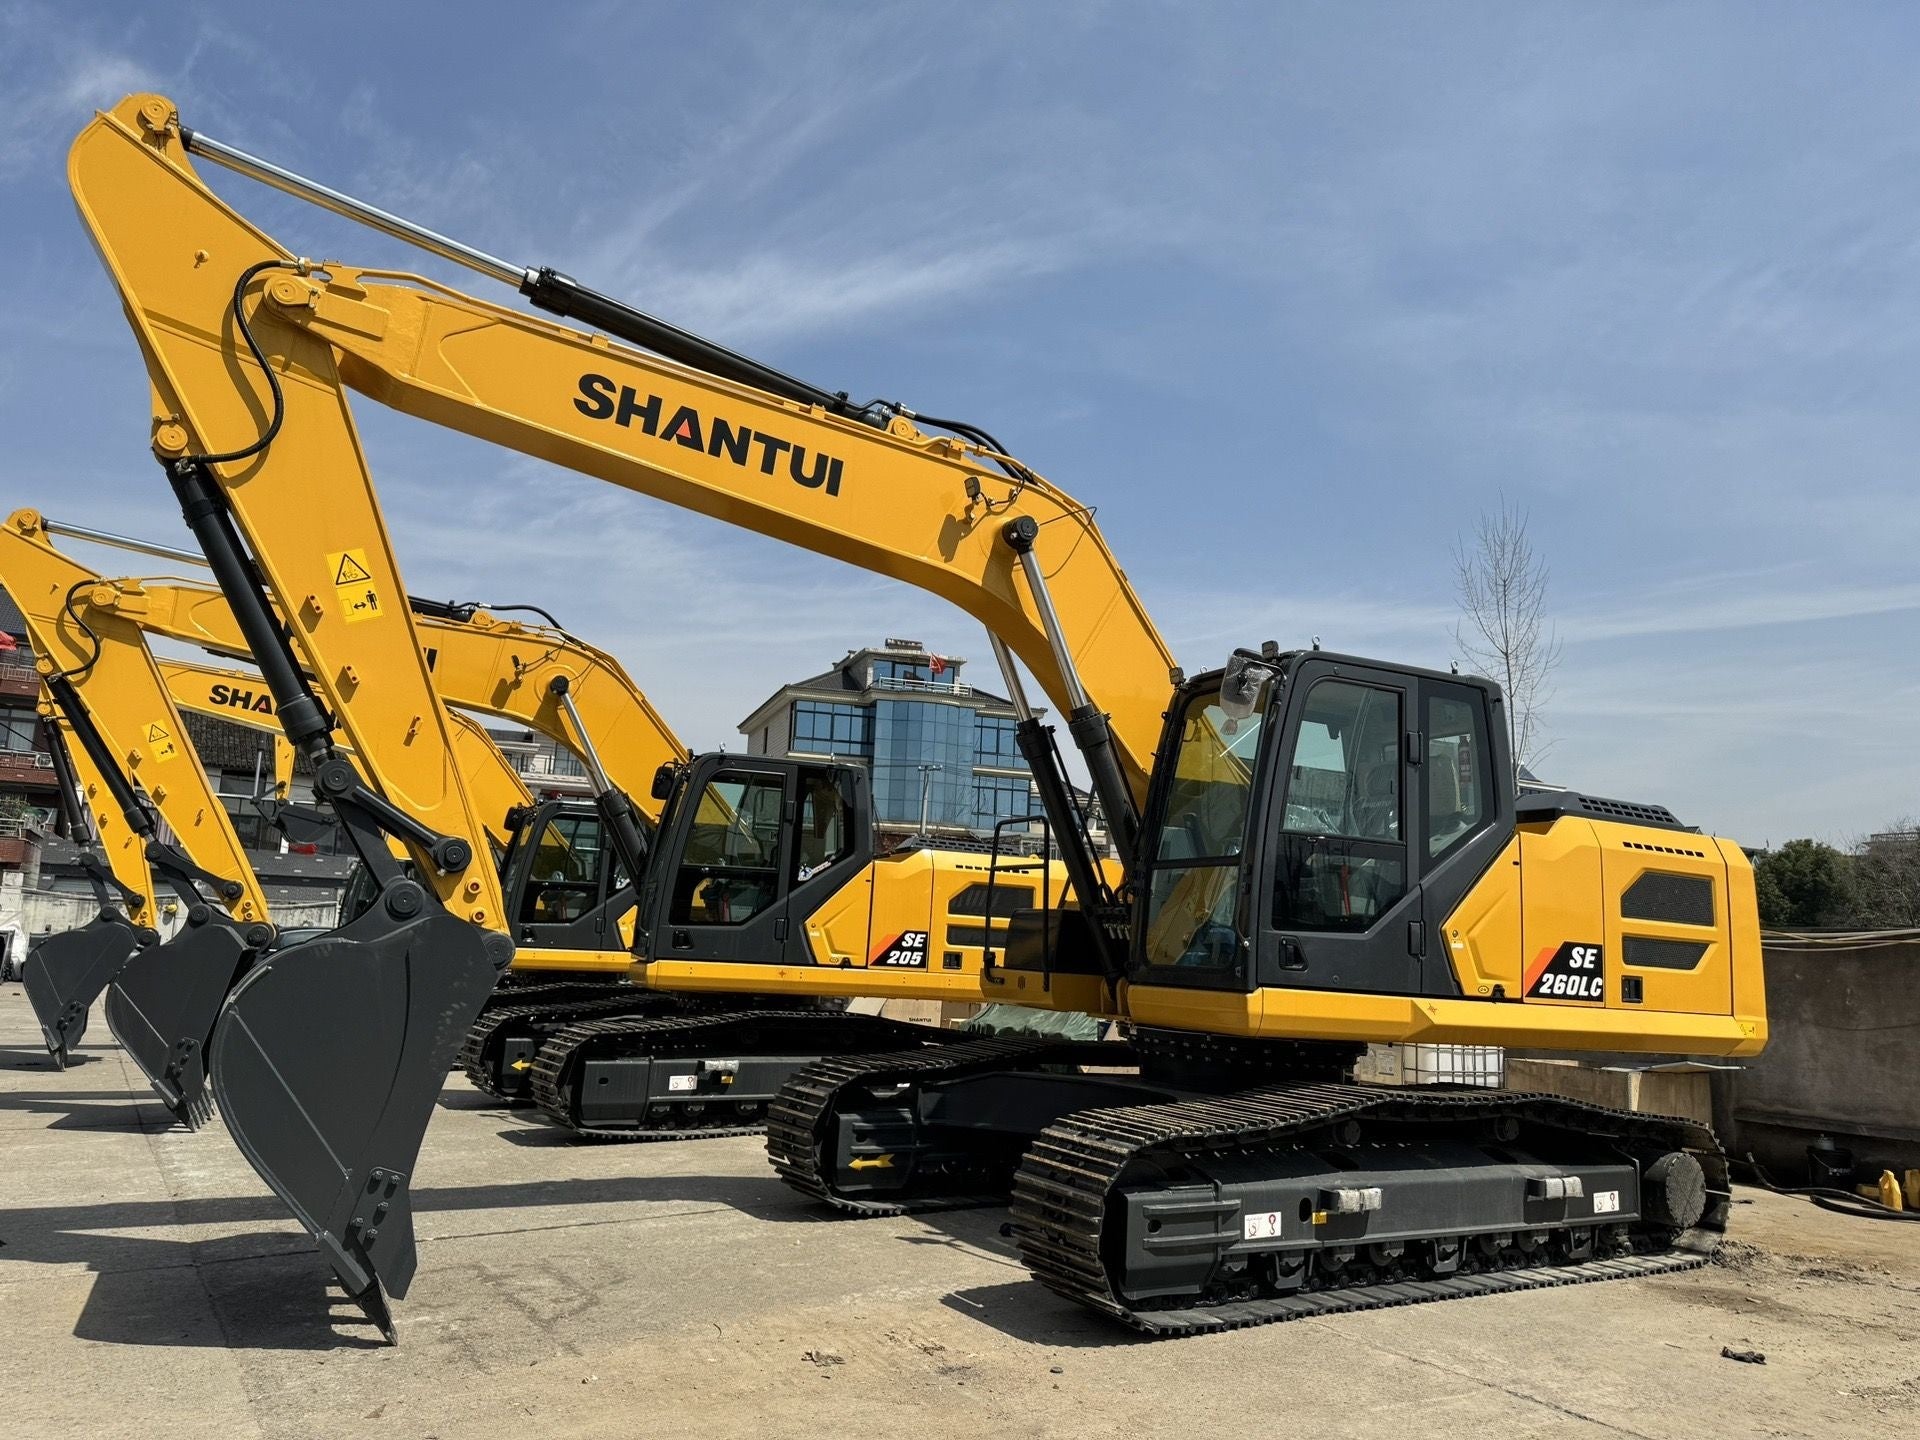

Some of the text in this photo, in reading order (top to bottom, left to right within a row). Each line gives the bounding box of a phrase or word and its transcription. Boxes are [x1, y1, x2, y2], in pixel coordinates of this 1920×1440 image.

[573, 373, 844, 497] SHANTUI
[208, 684, 278, 716] SHA
[901, 933, 926, 947] SE
[886, 950, 924, 965] 205
[1569, 946, 1598, 968] SE
[1539, 973, 1603, 997] 260LC
